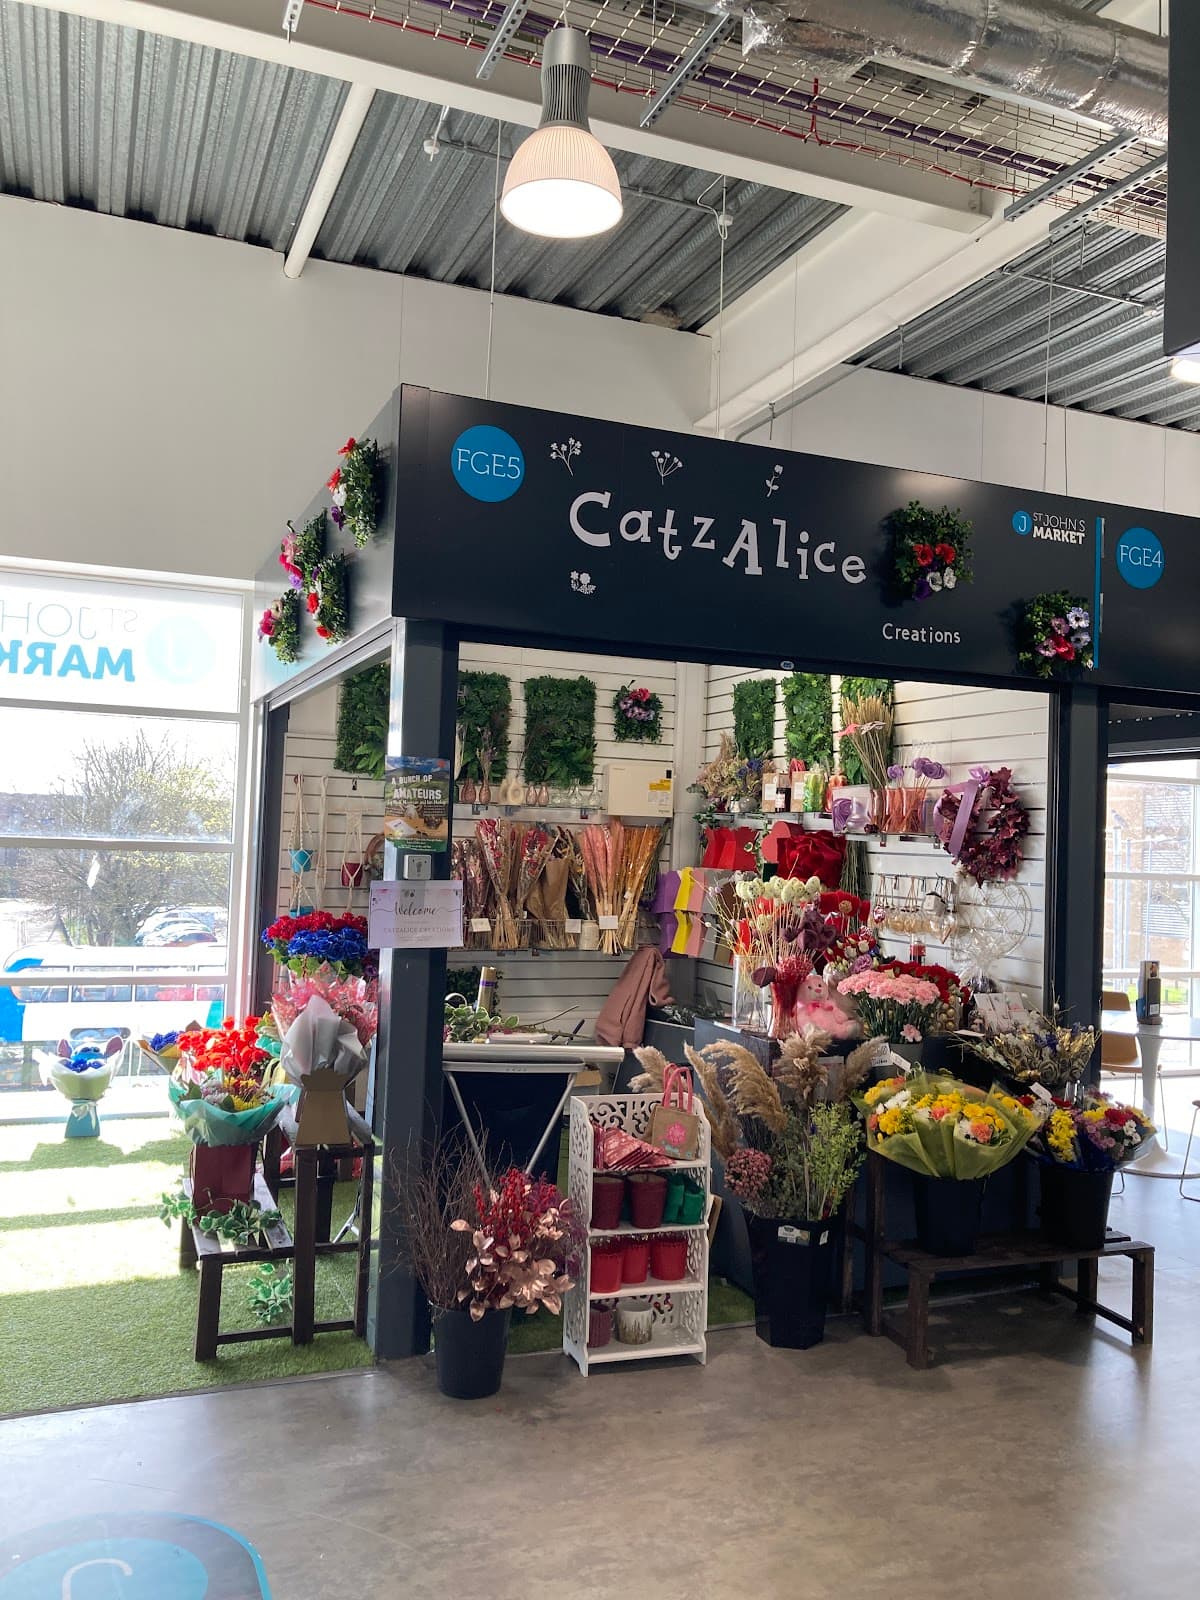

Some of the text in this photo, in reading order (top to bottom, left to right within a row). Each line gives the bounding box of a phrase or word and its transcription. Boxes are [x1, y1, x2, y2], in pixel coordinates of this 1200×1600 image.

[457, 448, 520, 479] FGE5
[1033, 512, 1043, 522] ST
[569, 491, 867, 584] CatzAlice
[1033, 526, 1086, 545] MARKET
[1119, 544, 1163, 568] FGE4
[882, 622, 961, 644] Creations
[391, 774, 433, 785] A BUNCH OF
[392, 787, 442, 800] AMATEURS
[394, 901, 437, 917] Welcome
